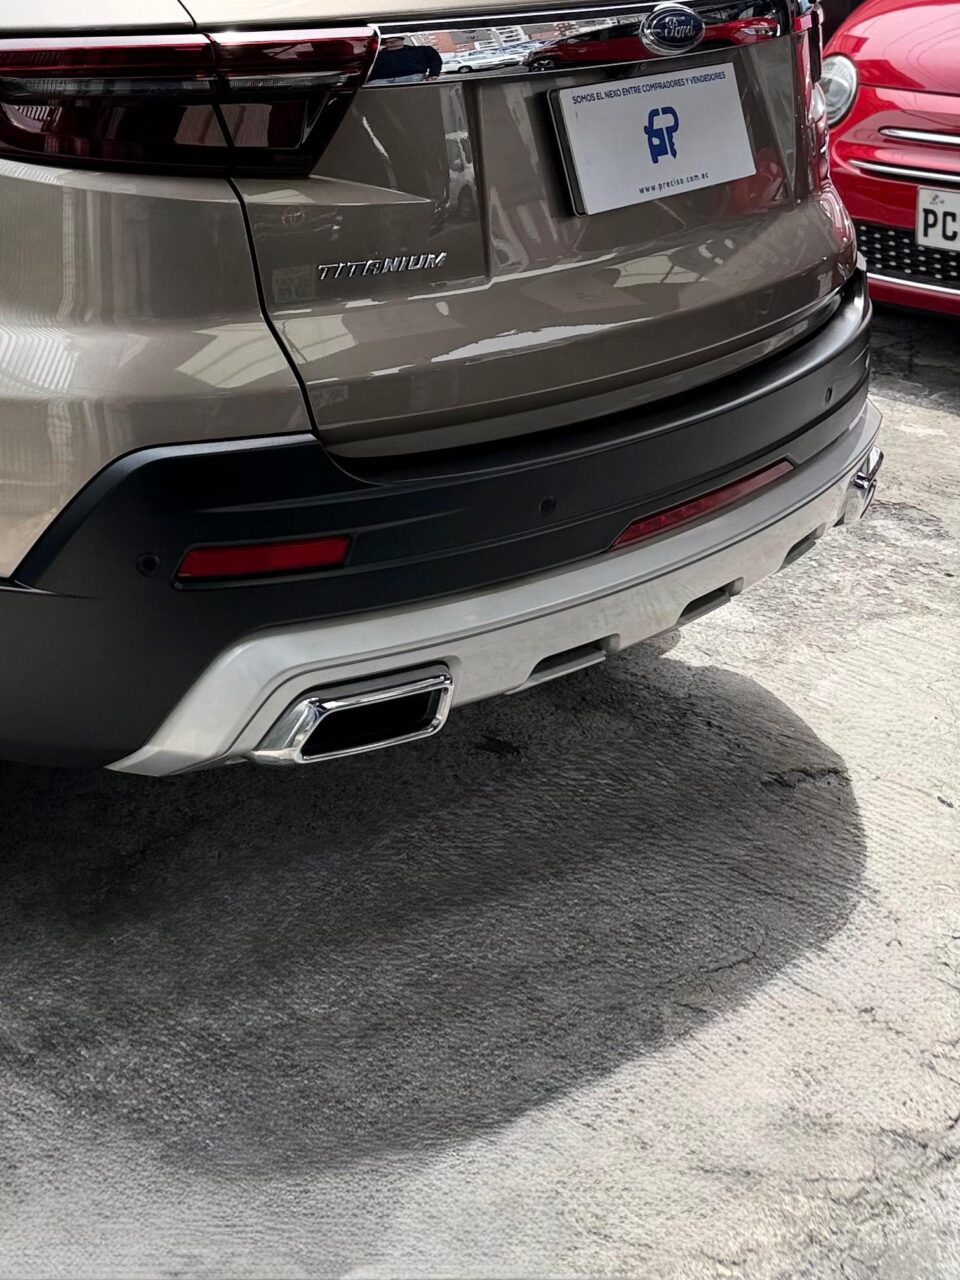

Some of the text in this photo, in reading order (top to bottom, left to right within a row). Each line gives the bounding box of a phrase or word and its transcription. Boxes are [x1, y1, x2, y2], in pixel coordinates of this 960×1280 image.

[660, 16, 696, 39] Ford
[572, 92, 596, 105] SOMOS
[596, 91, 604, 101] EL
[605, 88, 622, 99] NEXO
[622, 85, 642, 96] ENTRE
[641, 78, 686, 93] COMPRADORES
[690, 71, 726, 85] VENDEDORES
[317, 252, 448, 280] TITANIUM
